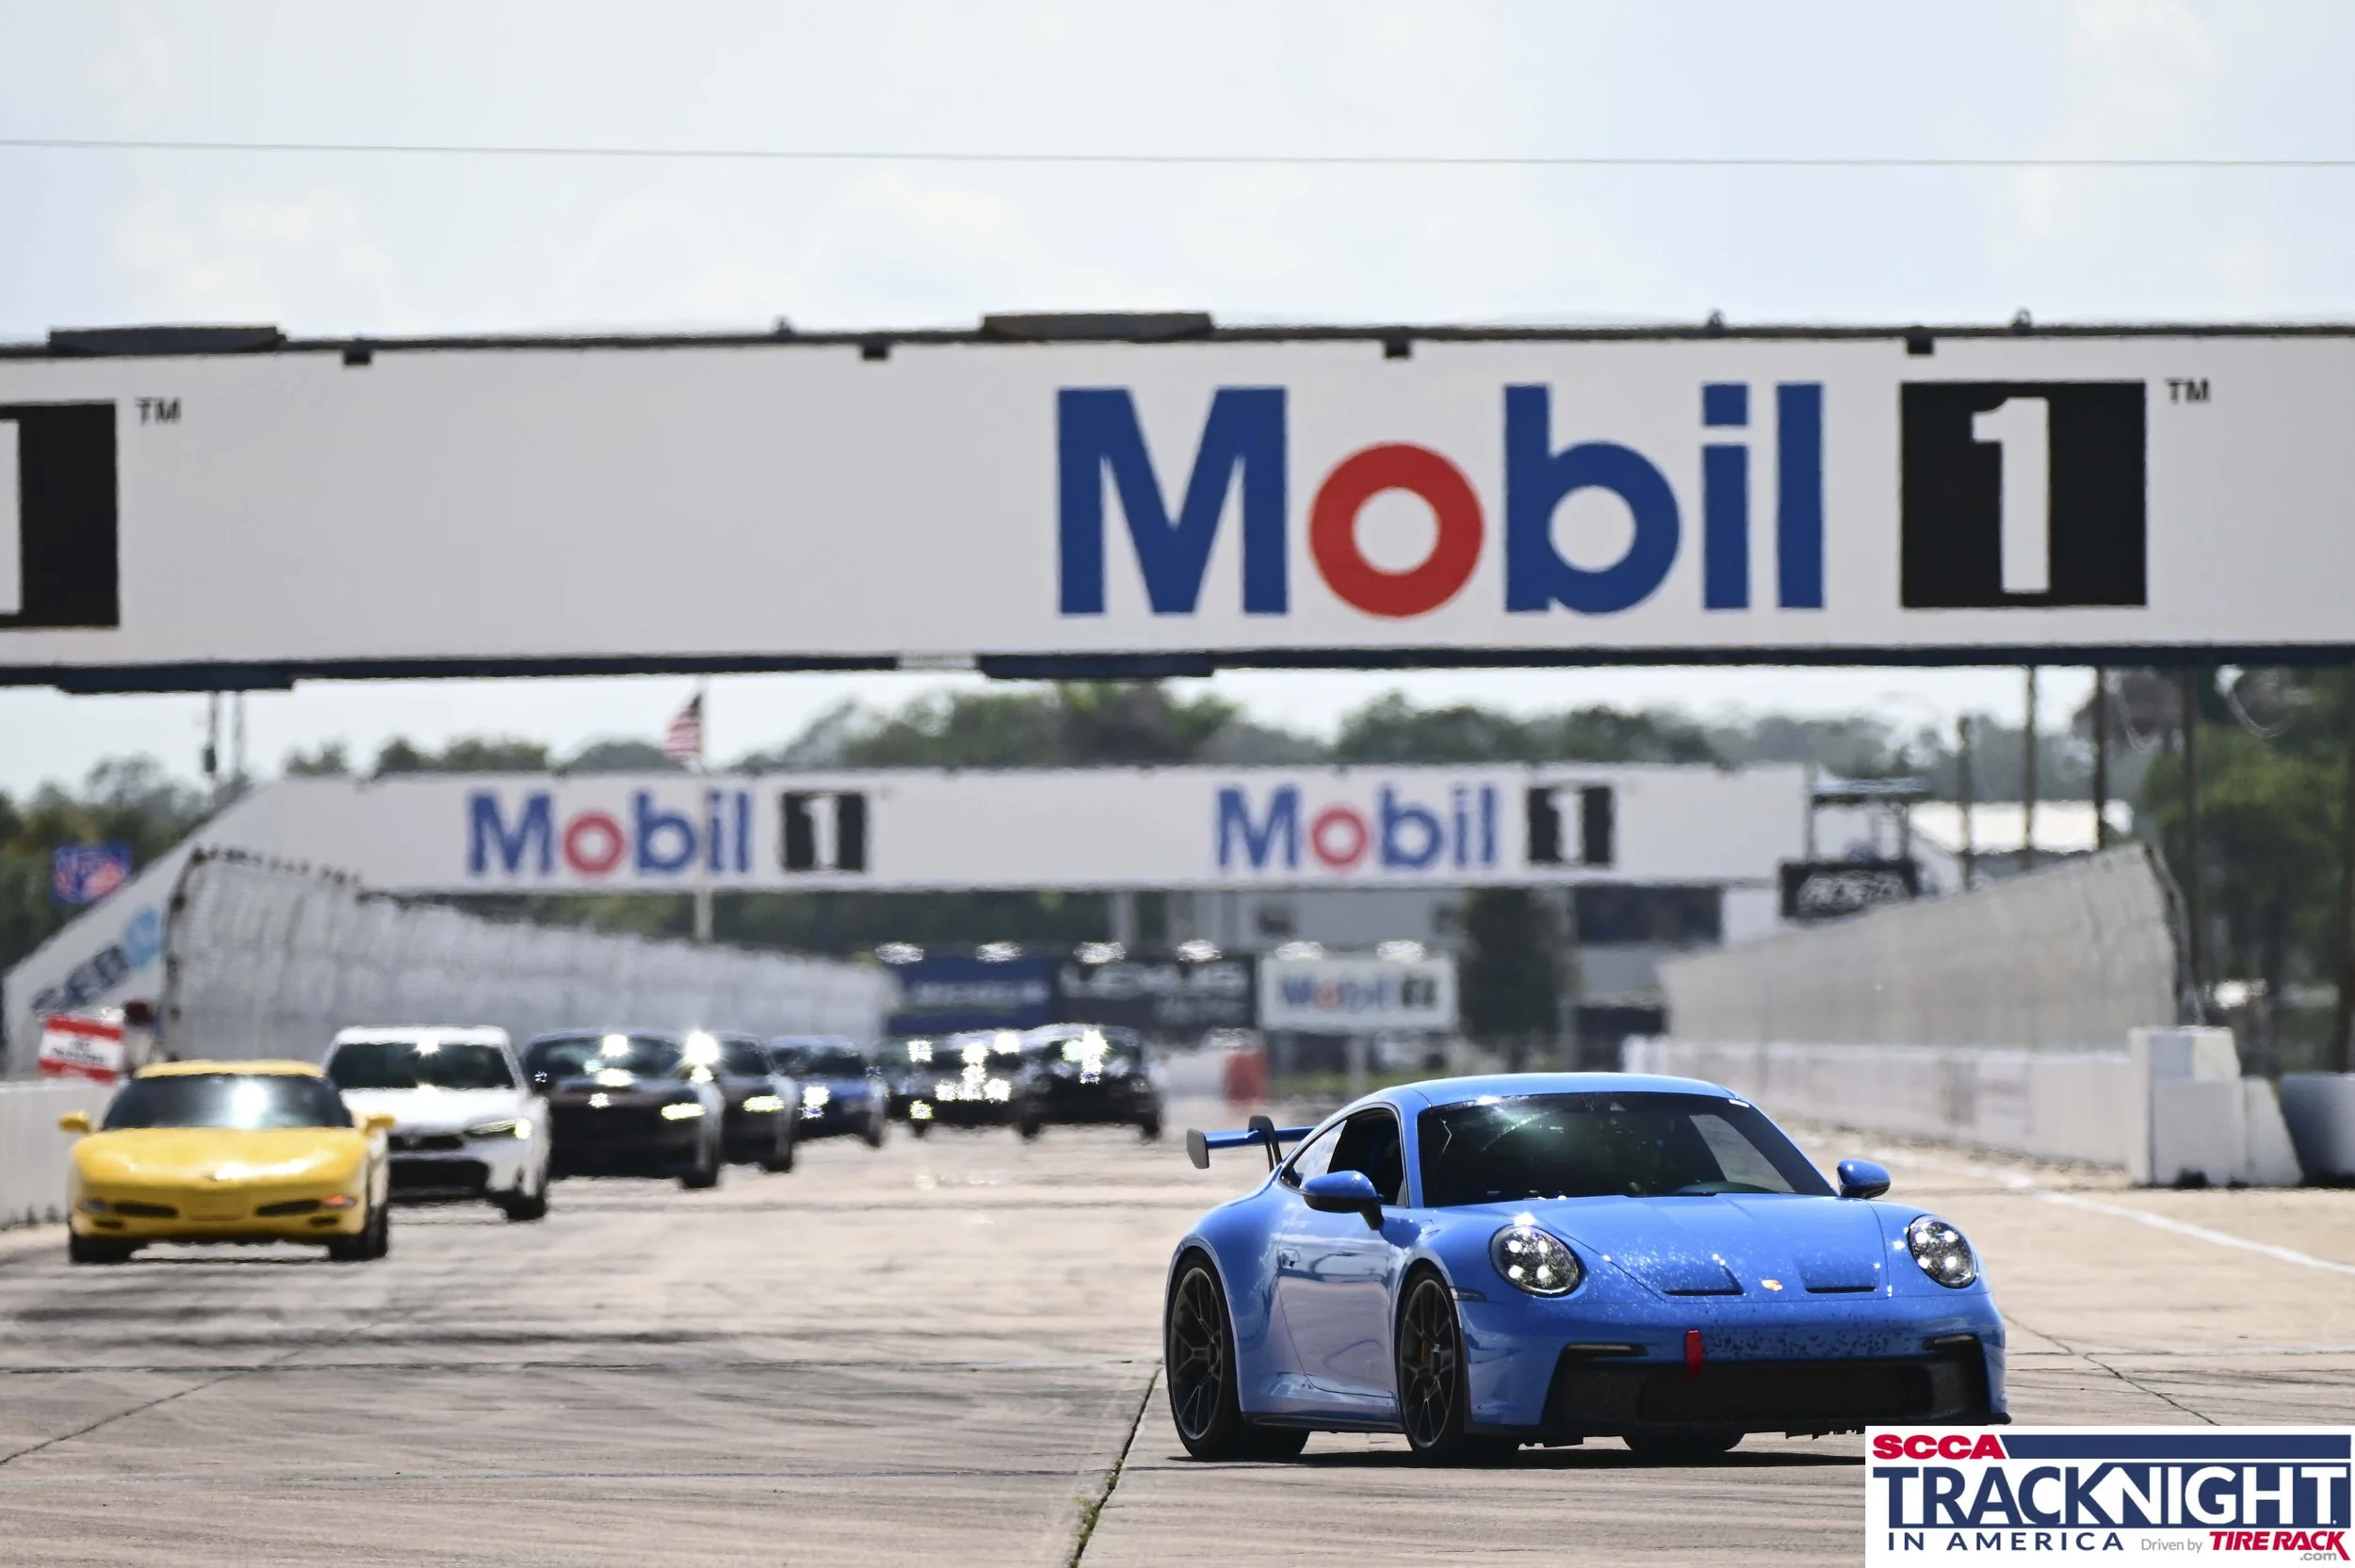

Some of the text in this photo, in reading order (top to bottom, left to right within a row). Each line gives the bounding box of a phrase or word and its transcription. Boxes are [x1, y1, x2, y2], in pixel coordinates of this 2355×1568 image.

[137, 397, 181, 424] TM
[1056, 382, 1825, 618] Mobil
[2164, 378, 2211, 404] TM
[466, 788, 753, 876] Mobil
[1214, 783, 1498, 869] Mobil
